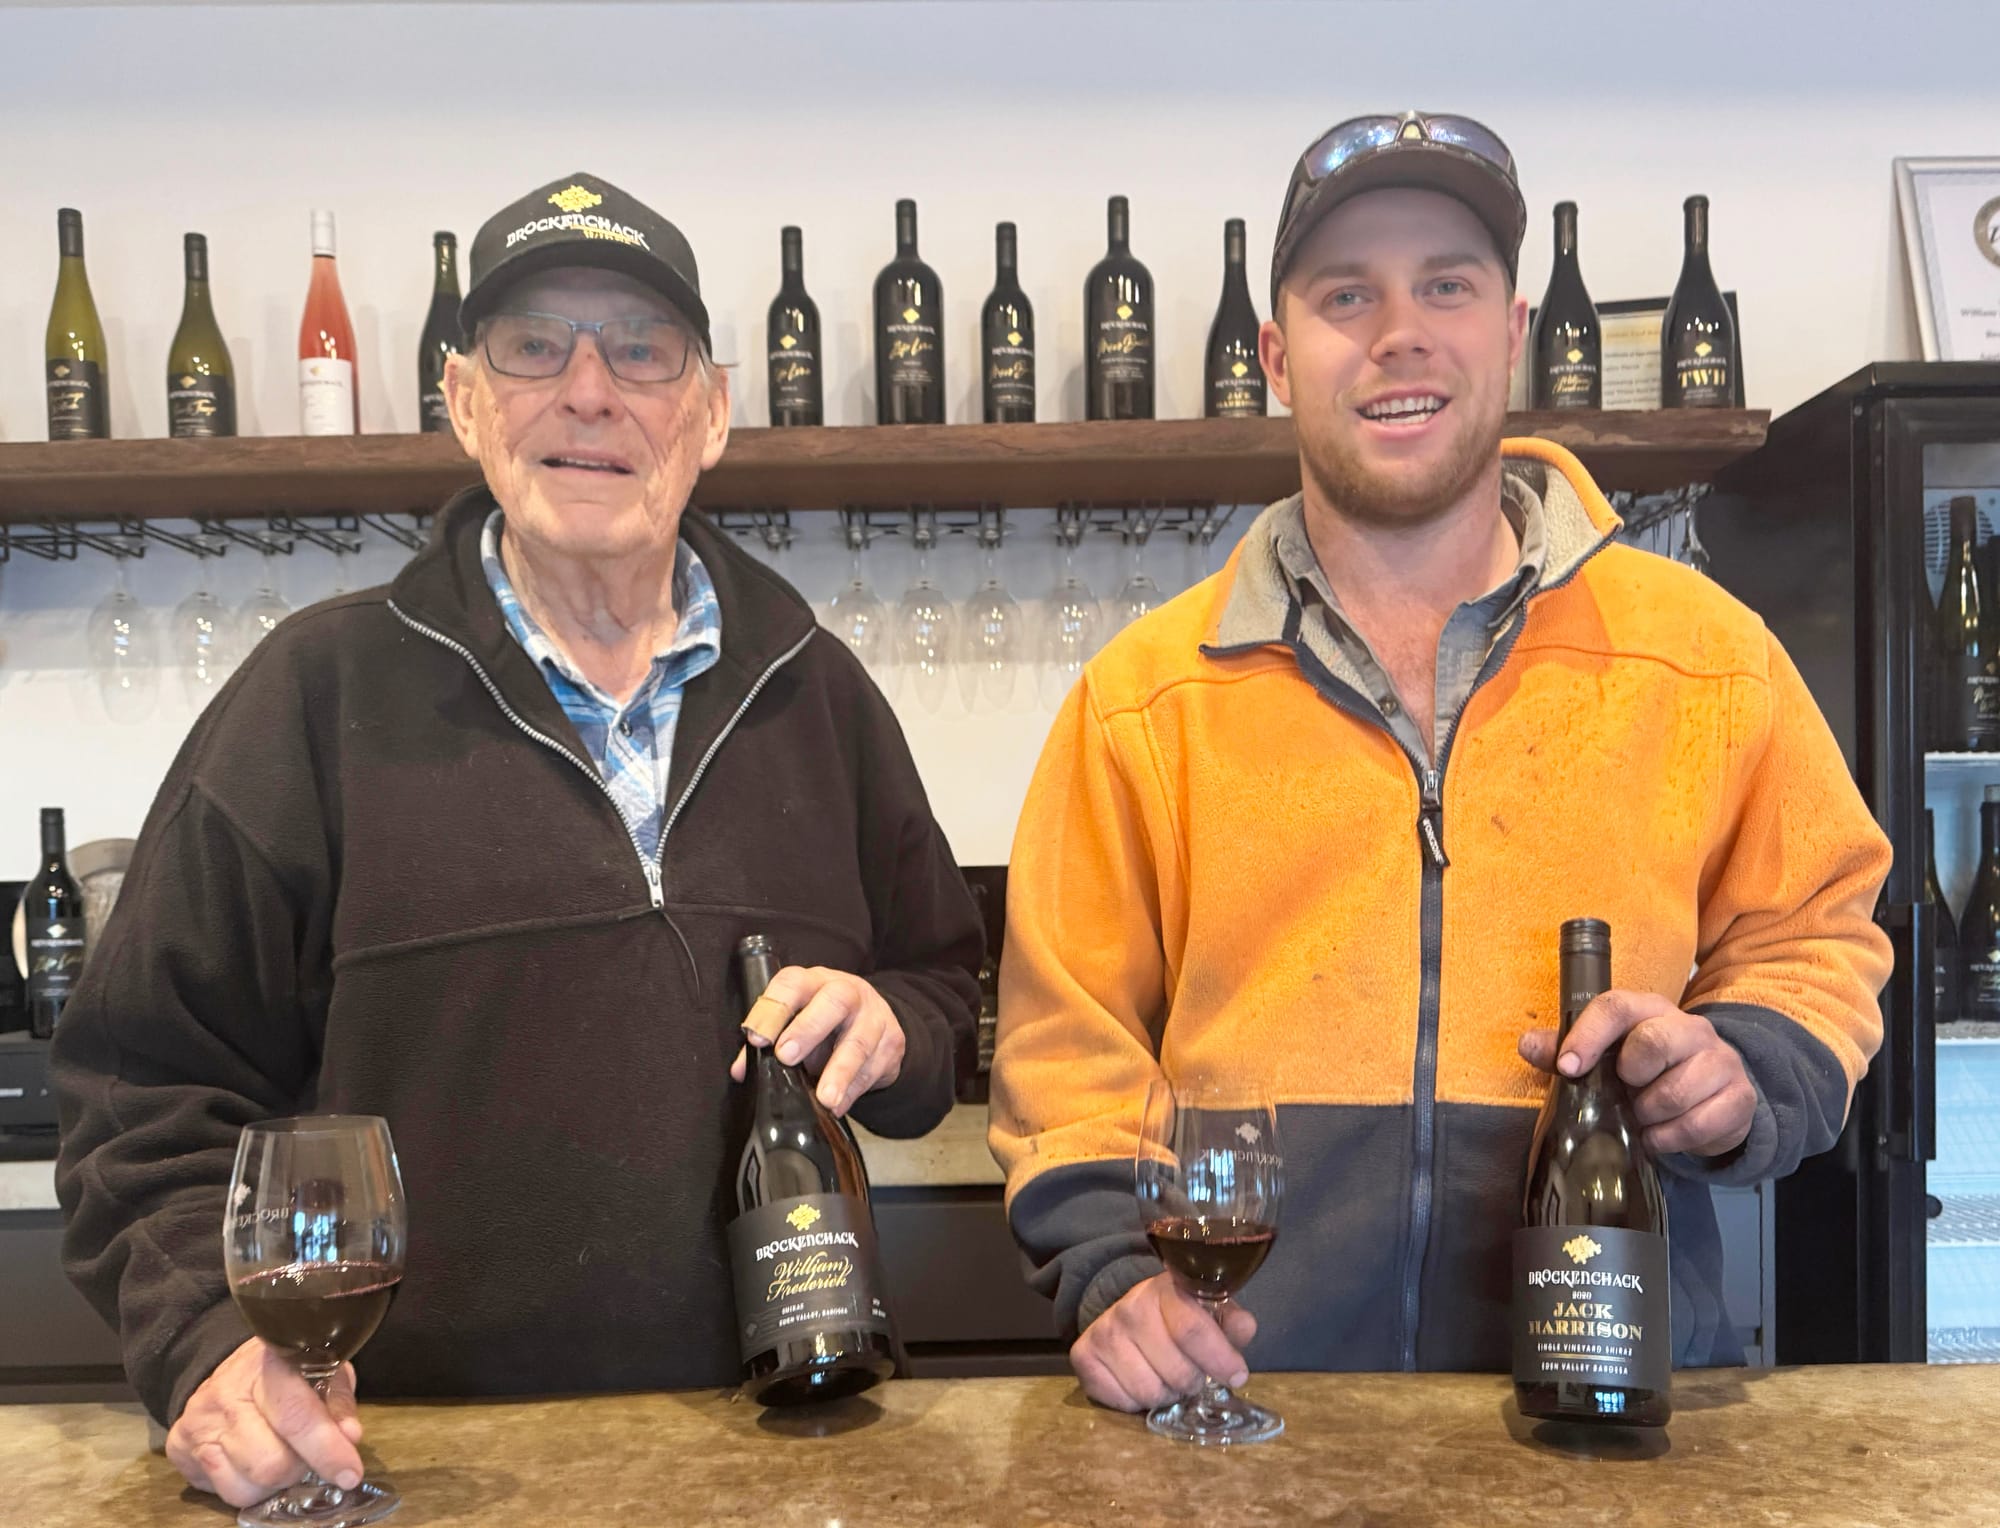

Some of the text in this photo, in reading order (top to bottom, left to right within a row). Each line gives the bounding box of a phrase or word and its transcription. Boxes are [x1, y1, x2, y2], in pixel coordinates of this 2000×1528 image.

[506, 213, 650, 251] BROCKENCHACK
[755, 1231, 859, 1261] BROCKENCHACK
[774, 1251, 853, 1281] William
[766, 1272, 848, 1302] Frederick
[1528, 1269, 1643, 1294] BROCKENCHACK
[1553, 1301, 1614, 1319] JACK
[1528, 1320, 1643, 1341] HARRISON
[1563, 1343, 1602, 1353] VINEYARD
[1561, 1362, 1591, 1372] VALLEY
